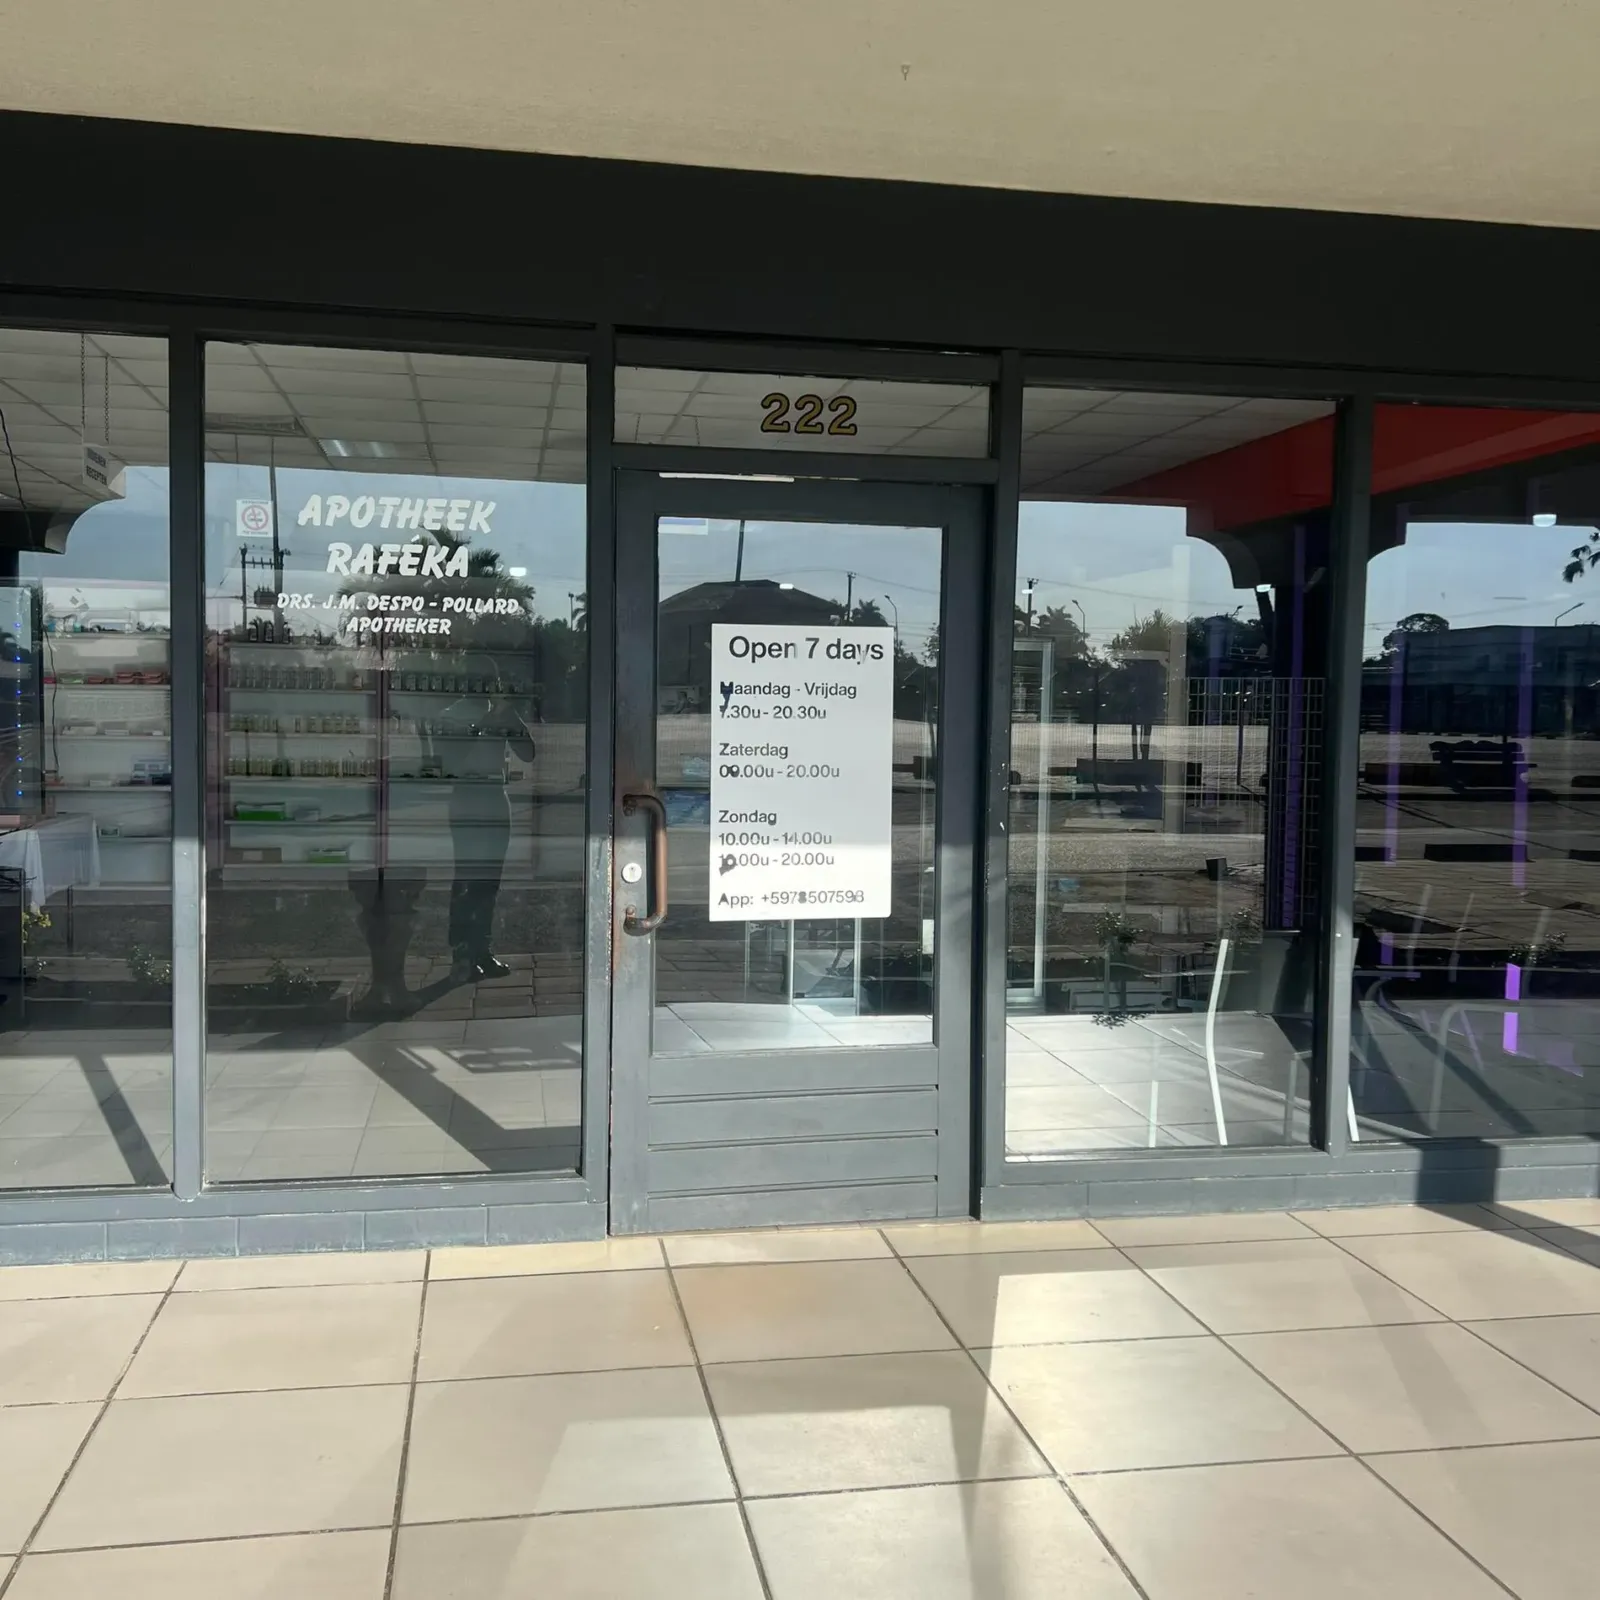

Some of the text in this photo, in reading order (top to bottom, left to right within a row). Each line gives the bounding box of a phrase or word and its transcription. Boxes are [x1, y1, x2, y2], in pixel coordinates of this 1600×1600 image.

[760, 392, 857, 436] 222
[297, 494, 498, 534] APOTHEEK
[326, 534, 469, 580] RAFÉKA
[277, 592, 316, 610] DRS.
[322, 594, 360, 611] J.M.
[367, 595, 424, 612] DESPO
[441, 597, 519, 615] POLLARD
[346, 617, 452, 635] APOTHEKER
[729, 636, 884, 665] Open 7 days
[804, 682, 857, 699] Vrijdag
[719, 743, 789, 759] Zaterdag
[786, 764, 840, 778] 20.00u
[718, 810, 777, 826] Zondag
[718, 832, 770, 846] 10.00u
[781, 852, 835, 866] 20.00u
[718, 892, 754, 908] App:
